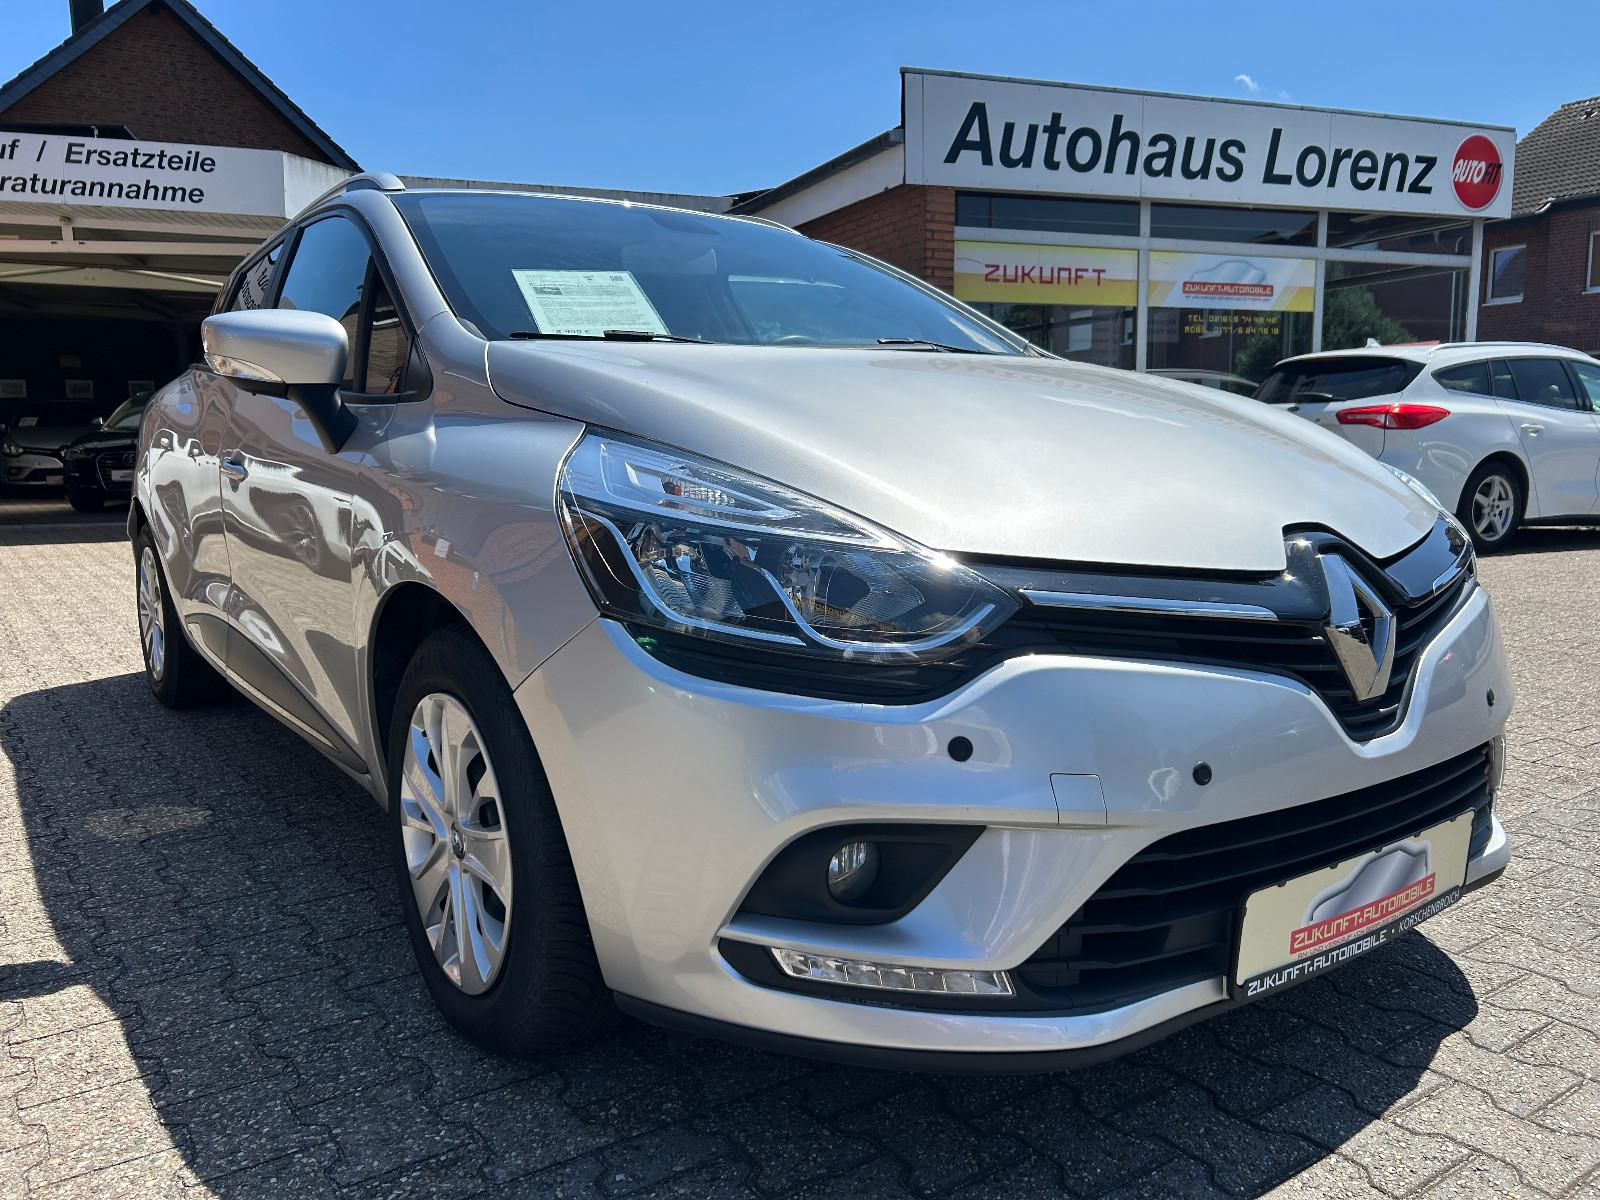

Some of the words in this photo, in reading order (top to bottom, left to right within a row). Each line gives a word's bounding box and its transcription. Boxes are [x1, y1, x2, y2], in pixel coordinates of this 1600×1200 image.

[36, 140, 47, 162] /
[65, 142, 216, 173] Ersatzteile
[943, 101, 1246, 183] Autohaus
[1261, 128, 1438, 195] Lorenz
[1453, 158, 1503, 185] AUTOFIT
[0, 173, 205, 204] raturannahme
[984, 264, 1106, 287] ZUKUNFT
[1294, 878, 1433, 949] ZUKUNFT.AUTOMOBILE
[1247, 929, 1387, 997] ZUKUNFT.AUTOMOBILE
[1399, 889, 1460, 933] KORSCHENBROICH
